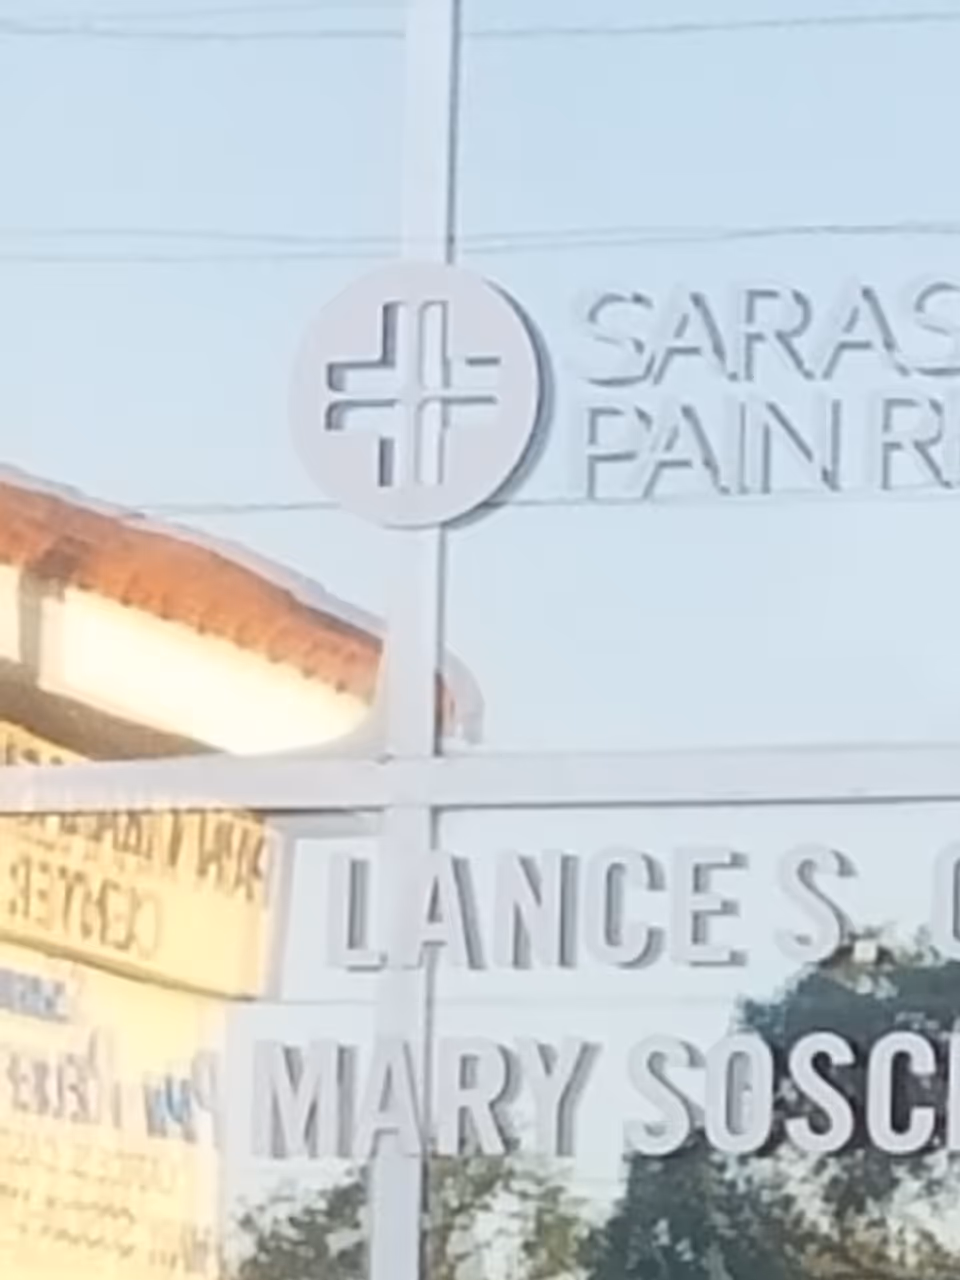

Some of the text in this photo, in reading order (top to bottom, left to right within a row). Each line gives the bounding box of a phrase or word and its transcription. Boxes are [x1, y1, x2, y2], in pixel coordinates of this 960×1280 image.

[583, 398, 844, 500] PAIN
[326, 846, 748, 972] LANCE
[250, 1035, 602, 1158] MARY
